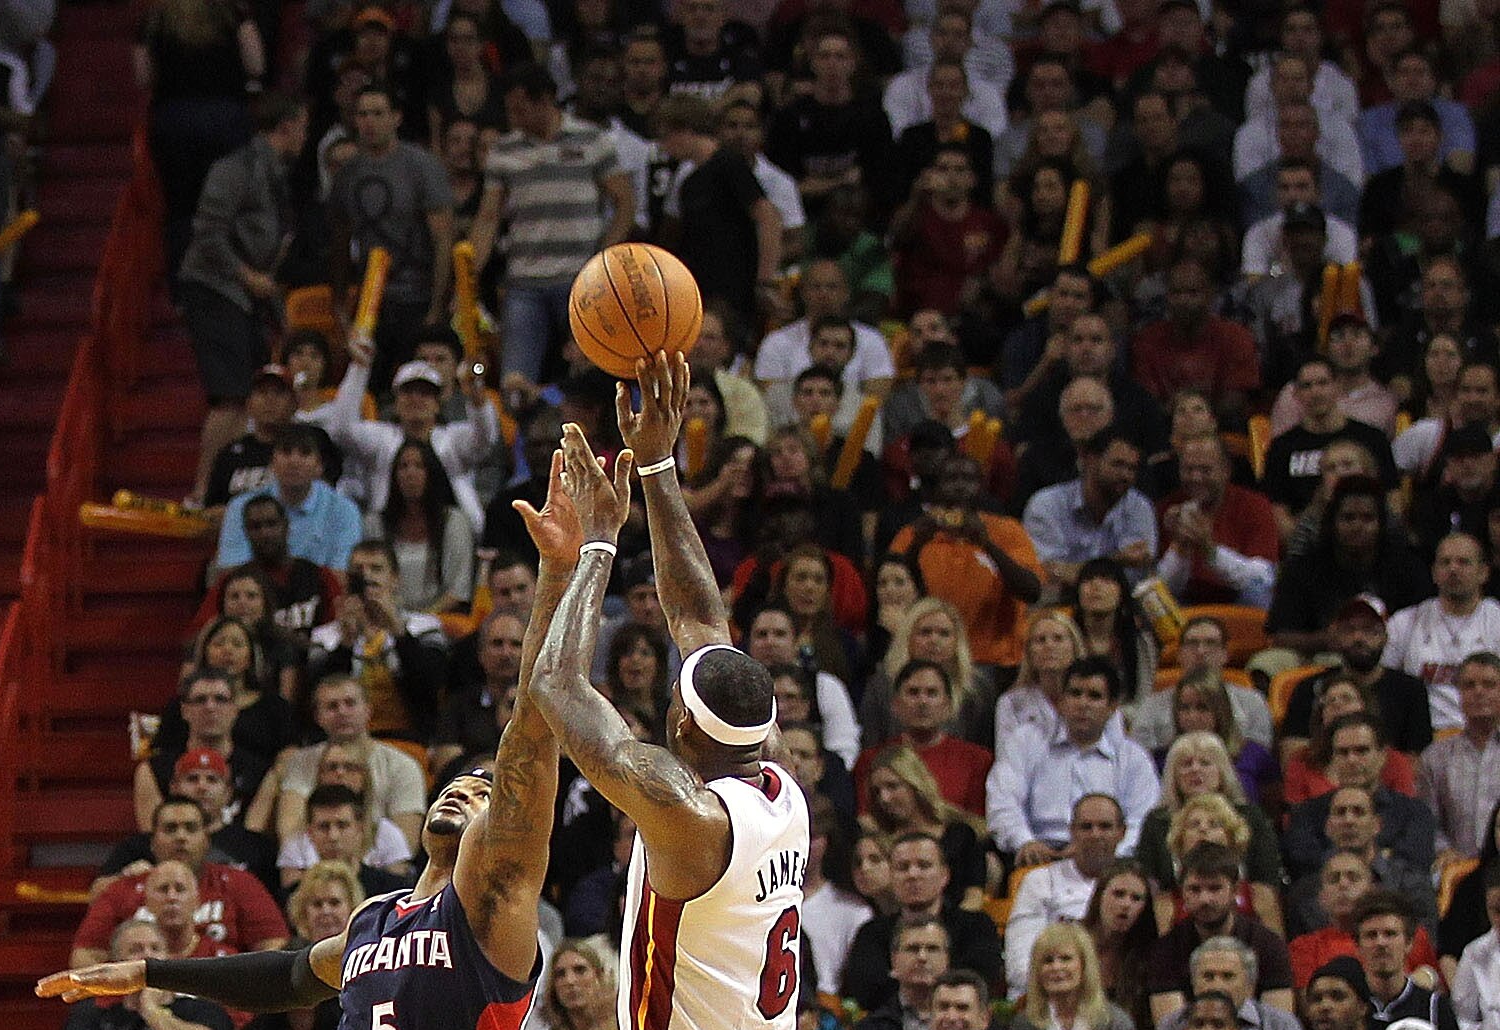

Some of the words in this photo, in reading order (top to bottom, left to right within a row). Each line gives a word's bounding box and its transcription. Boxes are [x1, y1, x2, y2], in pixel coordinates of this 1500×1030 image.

[756, 851, 807, 902] JAMES
[341, 930, 453, 989] ATLANTA
[757, 905, 799, 1020] 6
